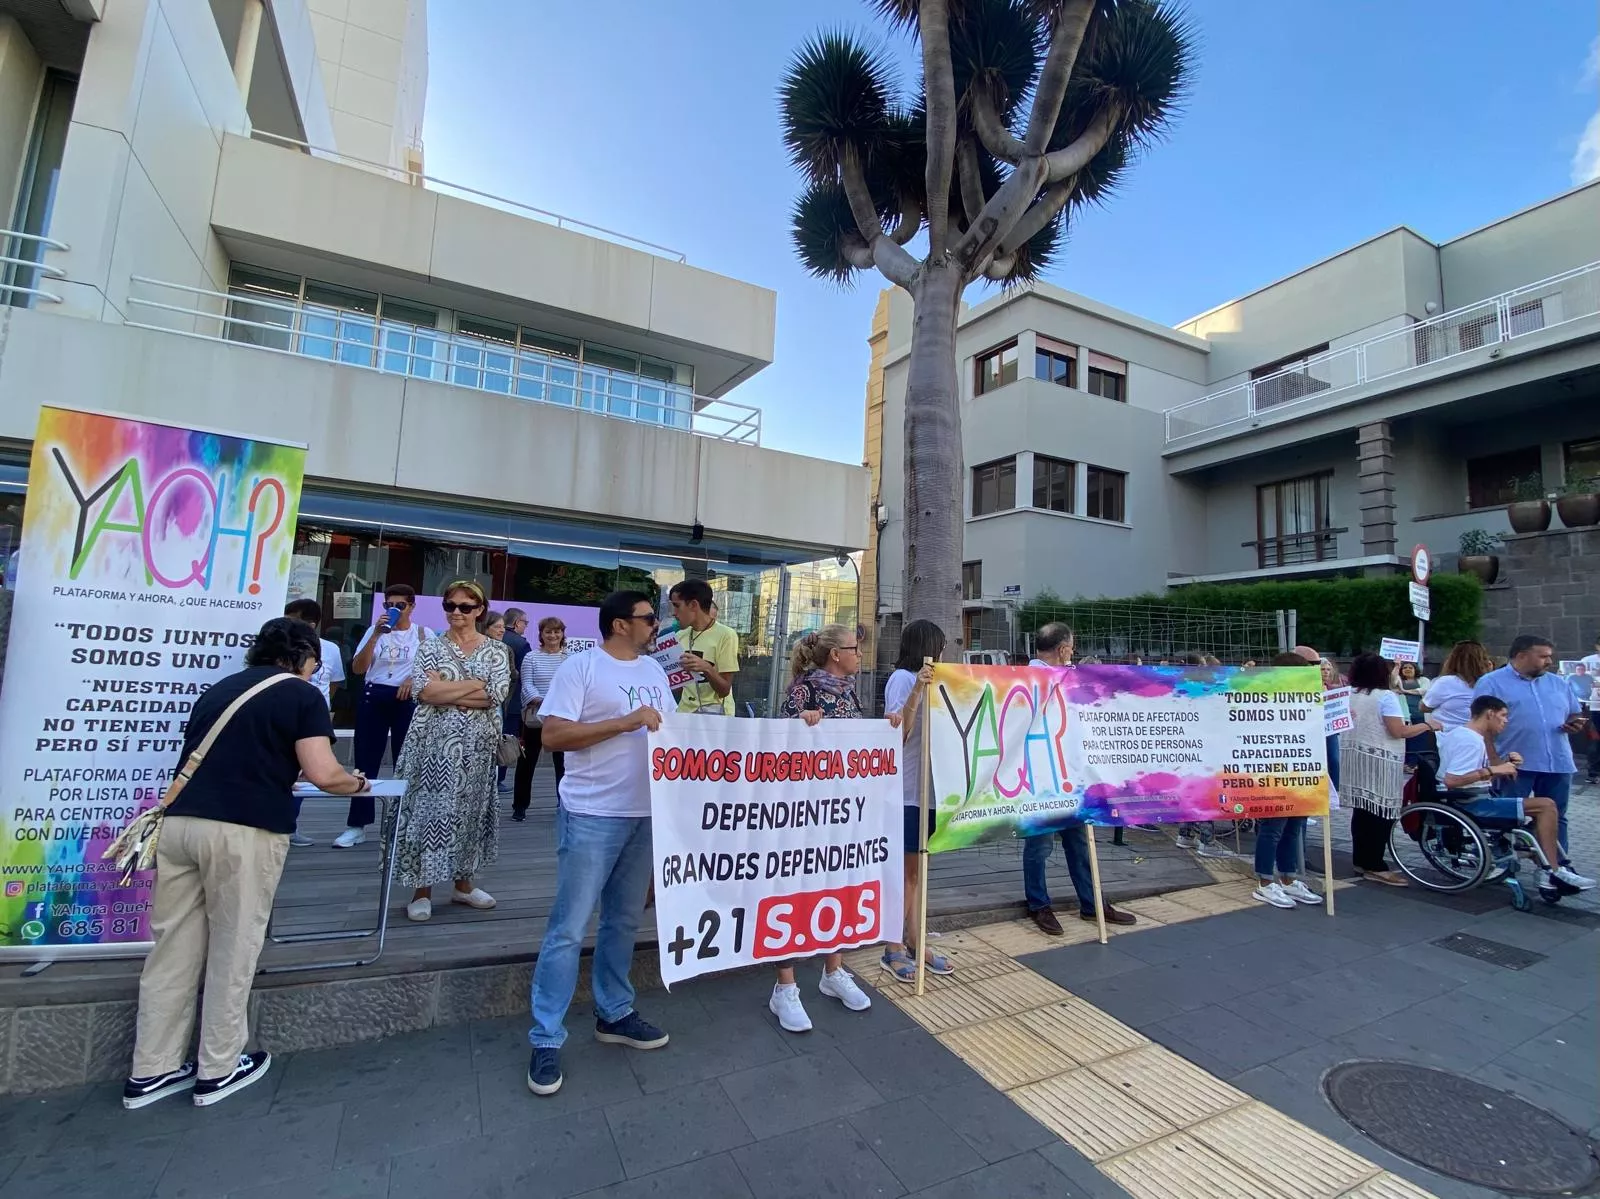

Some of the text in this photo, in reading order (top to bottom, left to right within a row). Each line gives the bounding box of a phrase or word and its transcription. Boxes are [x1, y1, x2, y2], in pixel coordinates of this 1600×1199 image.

[52, 447, 285, 596] YAQH?
[53, 586, 263, 611] PLATAFORMA Y AHORA, ¿QUE HACEMOS?
[162, 629, 253, 649] JUNTOS
[71, 648, 161, 668] SOMOS
[1273, 692, 1321, 703] JUNTOS
[1079, 711, 1199, 722] PLATAFORMA DE AFECTADOS
[1229, 709, 1274, 722] SOMOS
[43, 718, 75, 732] NO
[84, 719, 171, 733] TIENEN
[1092, 726, 1184, 736] POR LISTA DE ESPERA
[35, 738, 98, 752] PERO
[107, 736, 130, 752] SÍ
[938, 682, 1073, 799] YAQH?
[1099, 740, 1139, 750] CENTROS
[1141, 740, 1153, 749] DE
[1155, 739, 1203, 749] PERSONAS
[1151, 753, 1203, 763] FUNCIONAL
[1232, 748, 1312, 759] CAPACIDADES
[652, 747, 898, 783] SOMOS URGENCIA SOCIAL
[1223, 762, 1321, 774] NO TIENEN EDAD
[24, 768, 127, 782] PLATAFORMA
[131, 769, 152, 781] DE
[1222, 778, 1254, 788] PERO
[1258, 775, 1270, 788] SÍ
[50, 787, 82, 801] POR
[86, 787, 128, 801] LISTA
[133, 787, 154, 800] DE
[701, 796, 866, 831] DEPENDIENTES Y
[1019, 802, 1037, 814] ¿QUE
[1039, 799, 1079, 811] HACEMOS?
[14, 808, 55, 821] PARA
[60, 807, 134, 820] CENTROS
[15, 828, 49, 841] CON
[662, 837, 889, 888] GRANDES DEPENDIENTES
[51, 903, 107, 917] YAhora
[763, 889, 876, 949] S.O.S
[58, 917, 140, 937] 685 81
